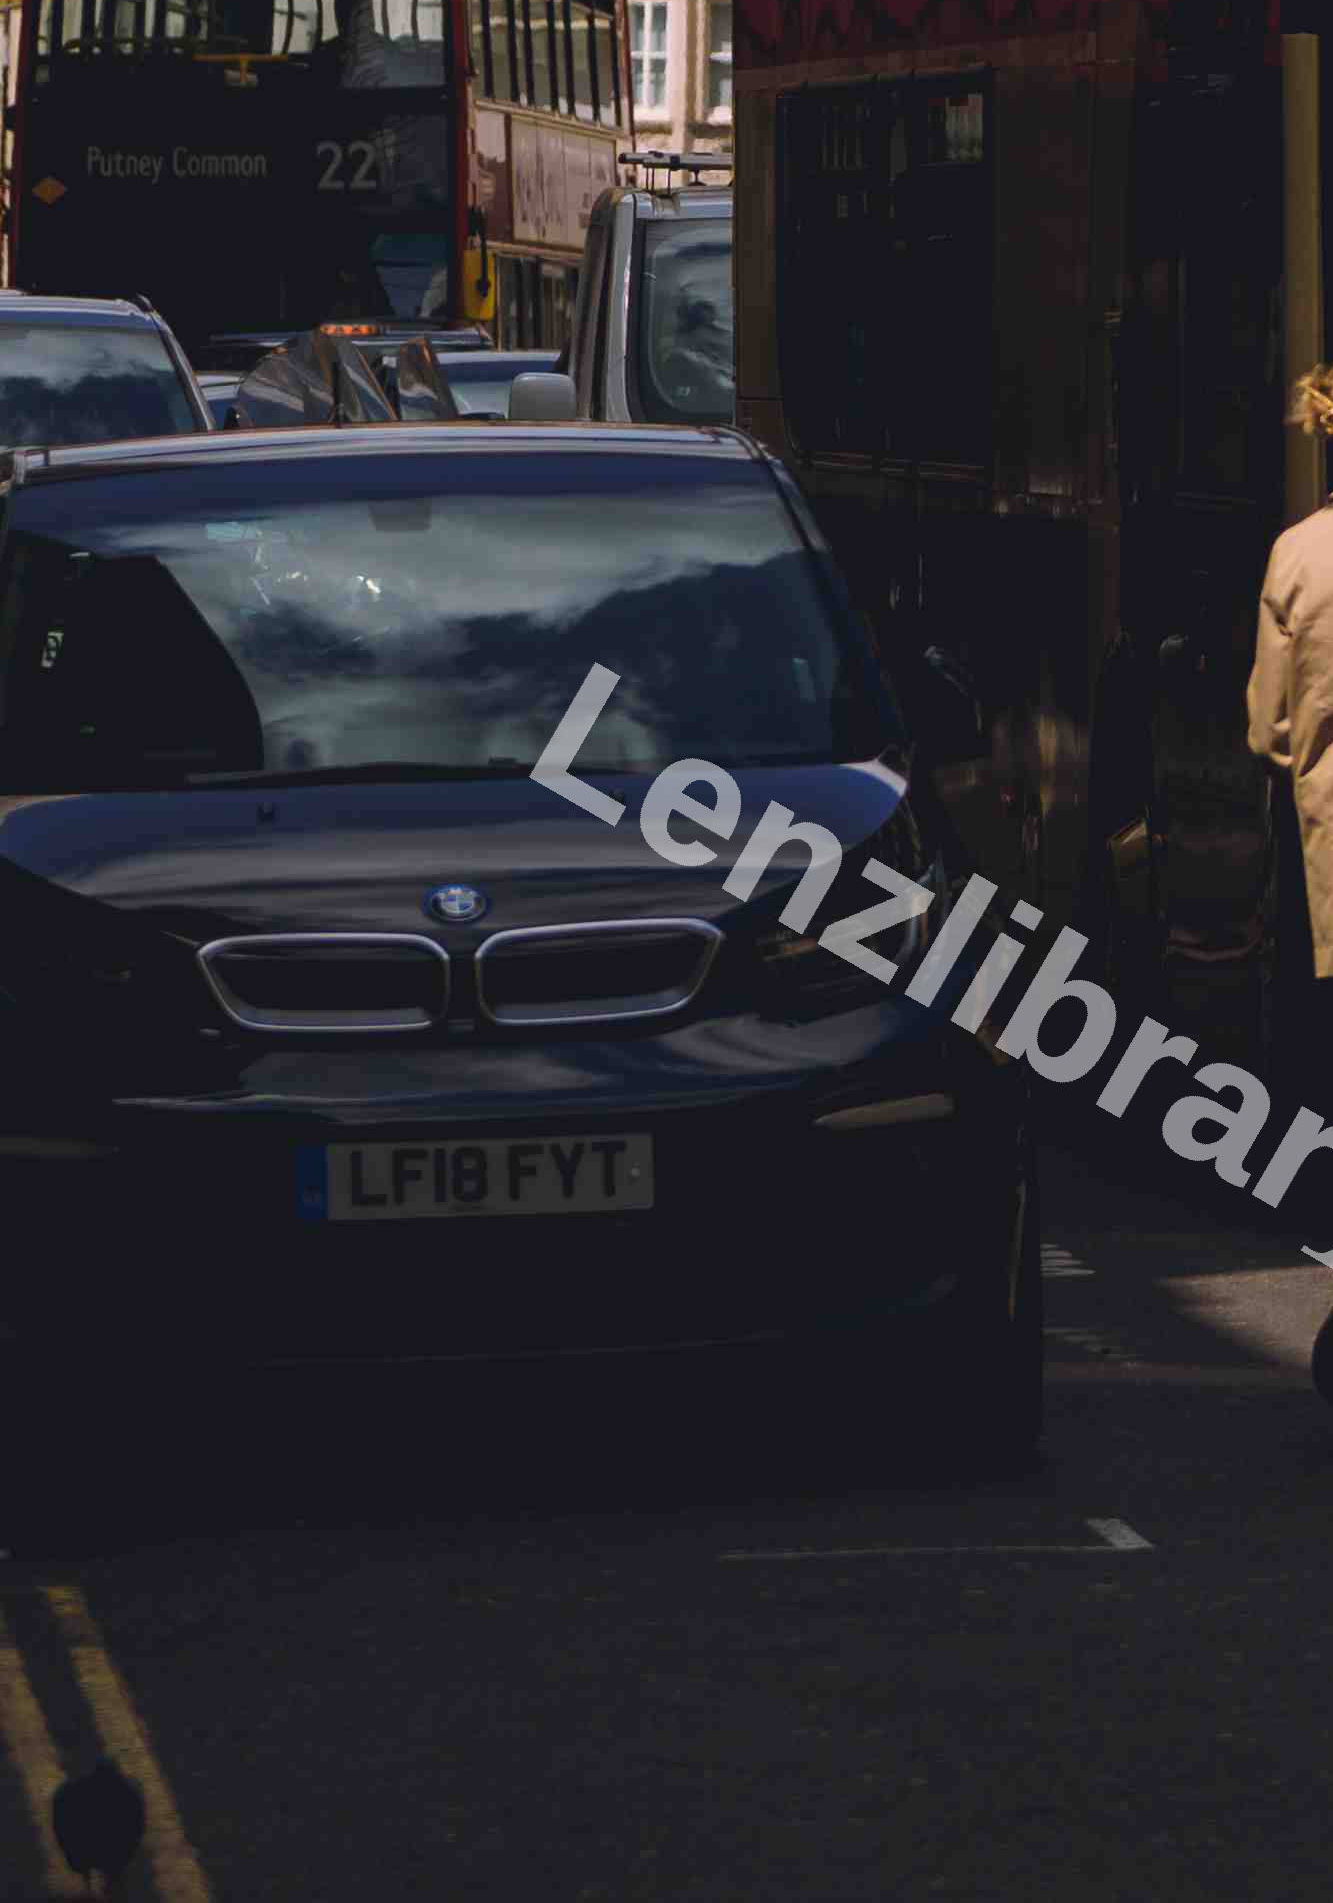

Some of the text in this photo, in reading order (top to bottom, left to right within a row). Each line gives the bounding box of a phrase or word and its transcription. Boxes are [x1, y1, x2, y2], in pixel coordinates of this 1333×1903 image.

[87, 140, 378, 191] Putney Common 22
[350, 1139, 628, 1207] LF18 FYT
